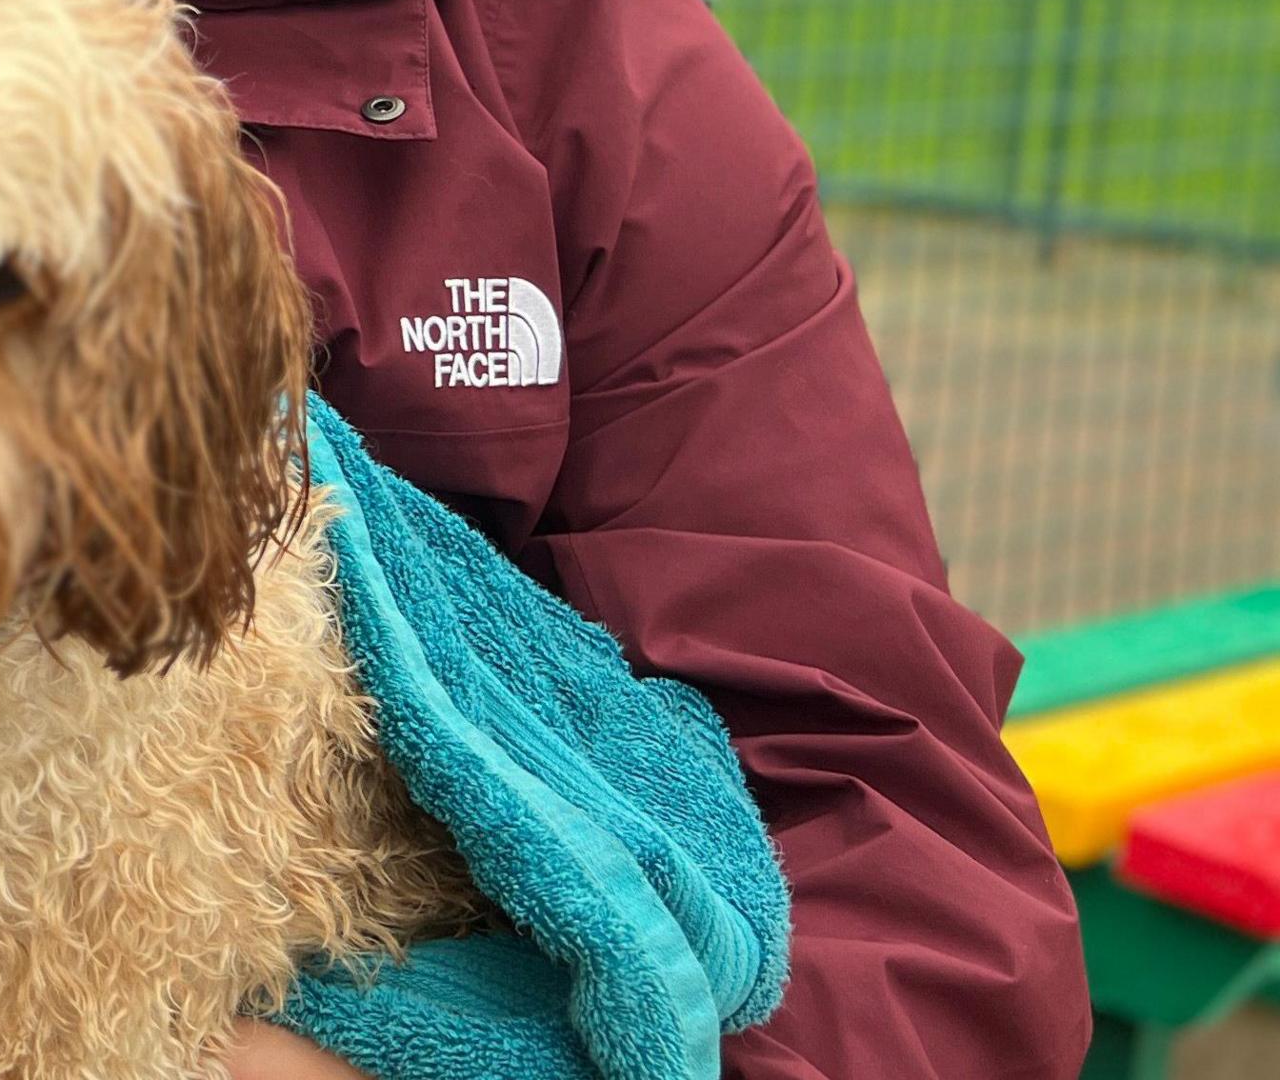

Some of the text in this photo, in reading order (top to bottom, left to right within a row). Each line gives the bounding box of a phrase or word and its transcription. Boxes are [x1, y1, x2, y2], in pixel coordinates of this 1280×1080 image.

[444, 277, 508, 313] THE
[399, 315, 507, 353] NORTH
[434, 352, 508, 388] FACE
